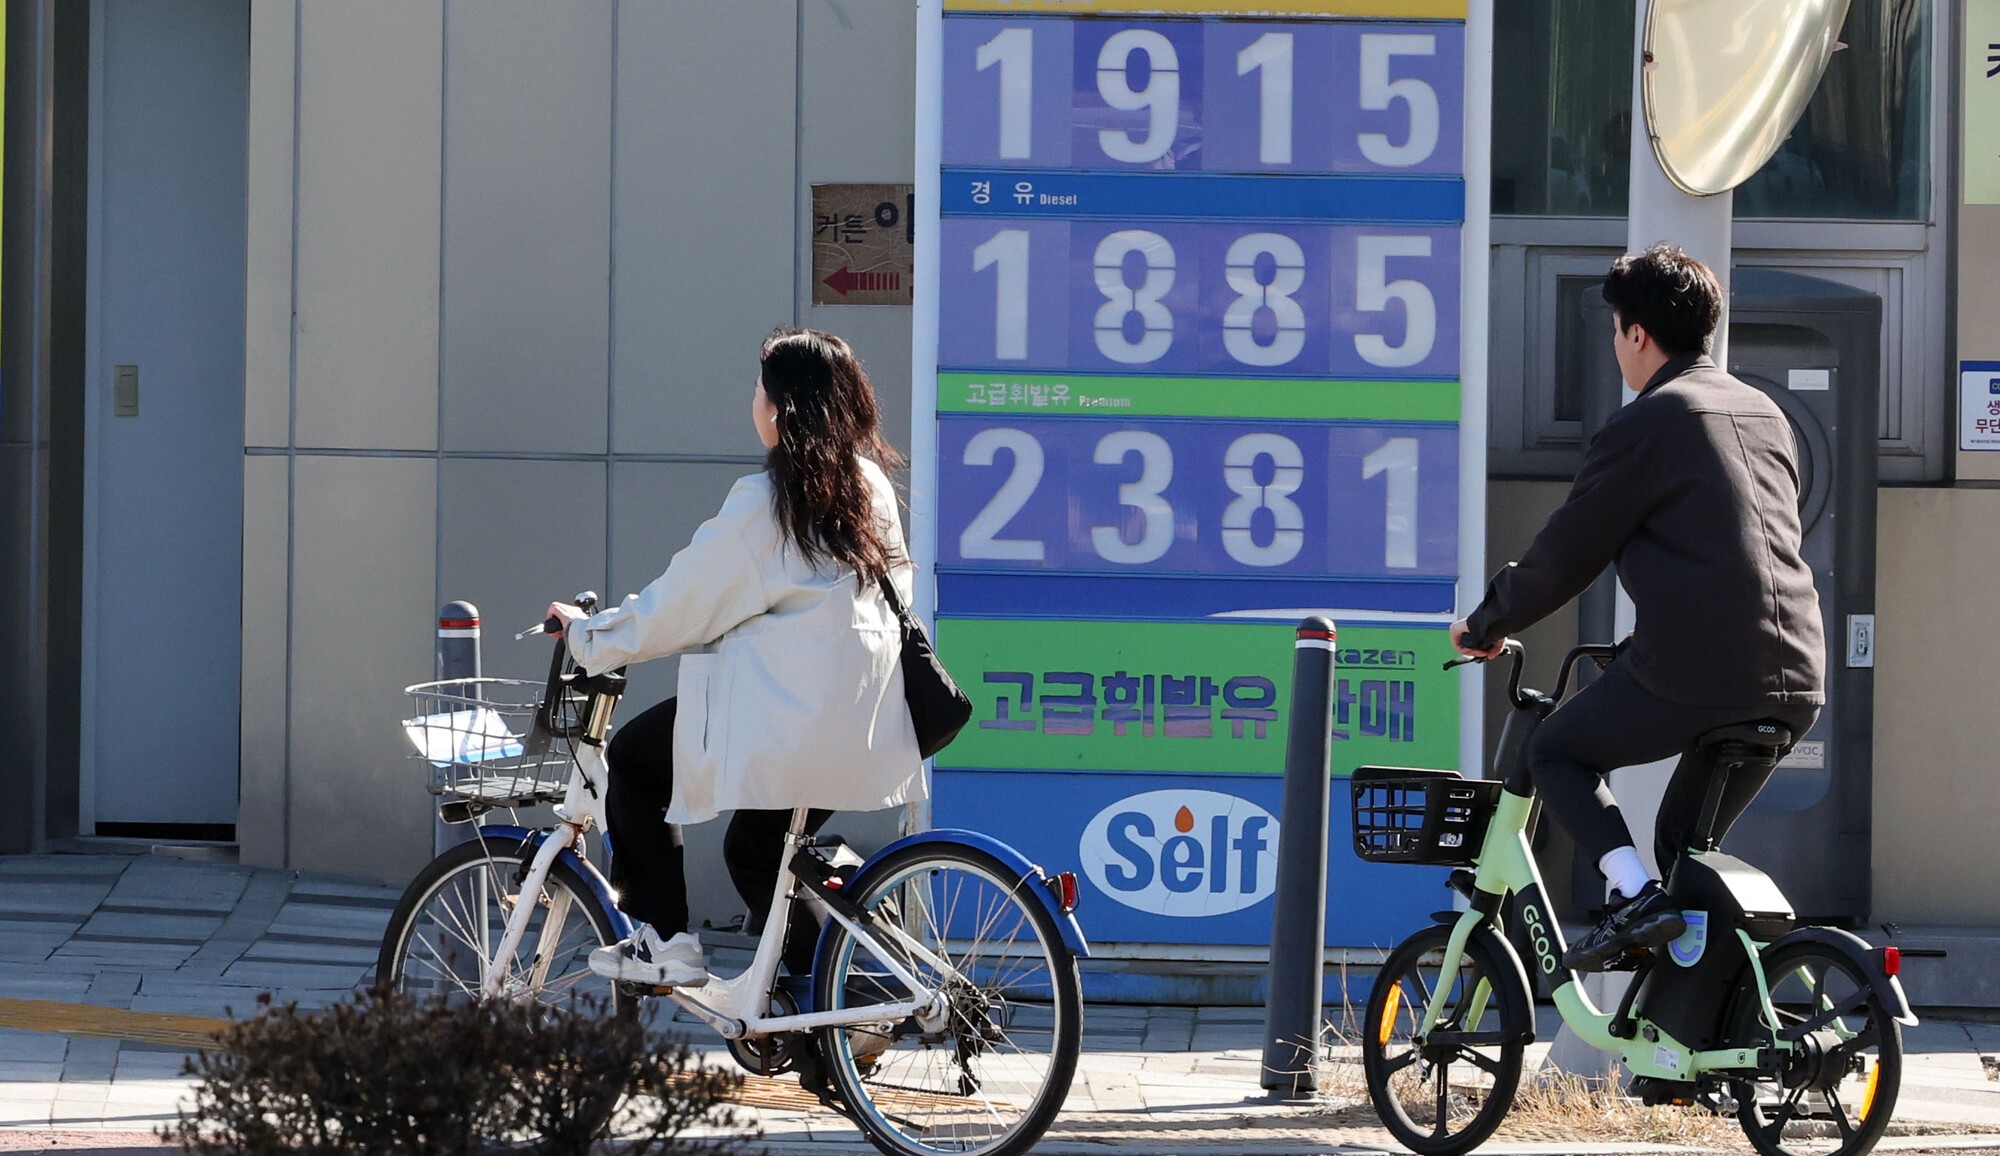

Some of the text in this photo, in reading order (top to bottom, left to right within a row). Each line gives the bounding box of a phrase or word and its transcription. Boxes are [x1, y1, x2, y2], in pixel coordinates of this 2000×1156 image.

[975, 28, 1440, 167] 1915
[816, 213, 867, 243] 커튼
[1039, 193, 1077, 205] Diesel
[972, 229, 1437, 367] 1885
[966, 383, 1131, 408] 고급휘발유 Premium
[959, 428, 1420, 568] 2381
[978, 670, 1278, 739] 고급휘발유
[1757, 725, 1776, 734] GCOO
[1104, 810, 1269, 894] Self
[1523, 904, 1557, 975] GCOO
